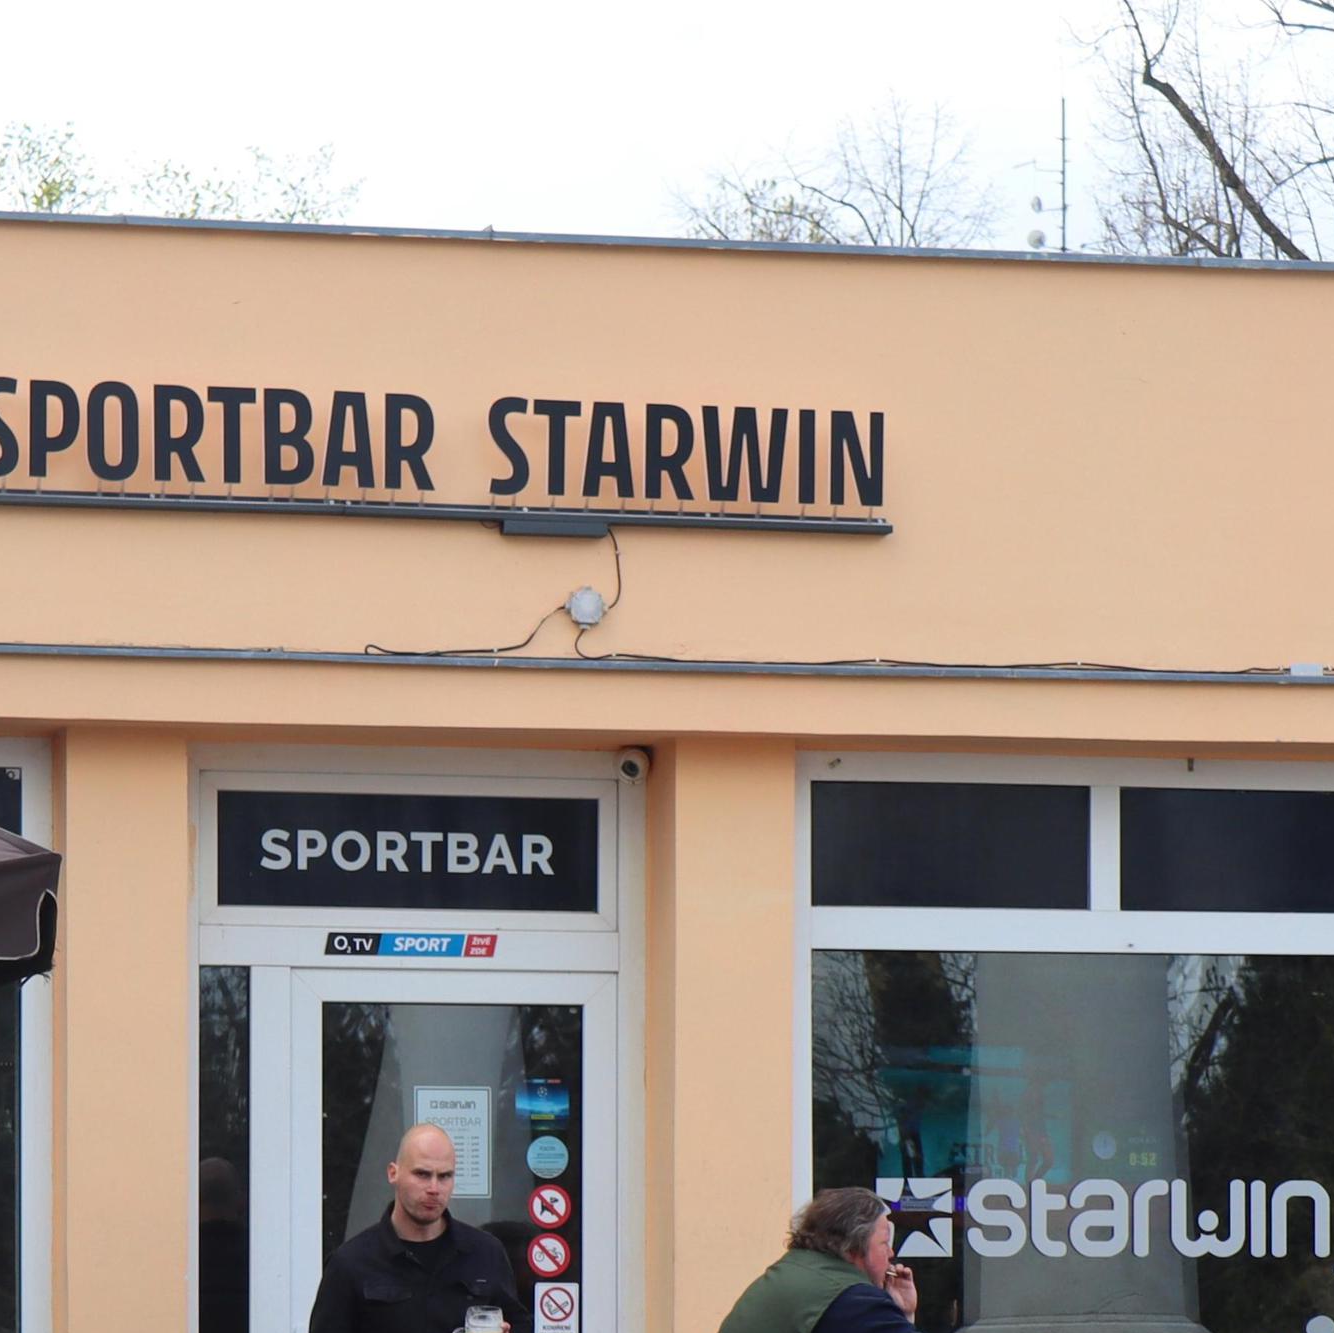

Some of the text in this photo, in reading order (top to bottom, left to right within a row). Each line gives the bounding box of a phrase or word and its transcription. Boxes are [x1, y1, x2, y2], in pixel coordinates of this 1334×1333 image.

[488, 396, 884, 506] STARWIN
[260, 829, 555, 876] SPORTBAR
[393, 936, 452, 953] SPORT
[967, 1178, 1331, 1257] starwin
